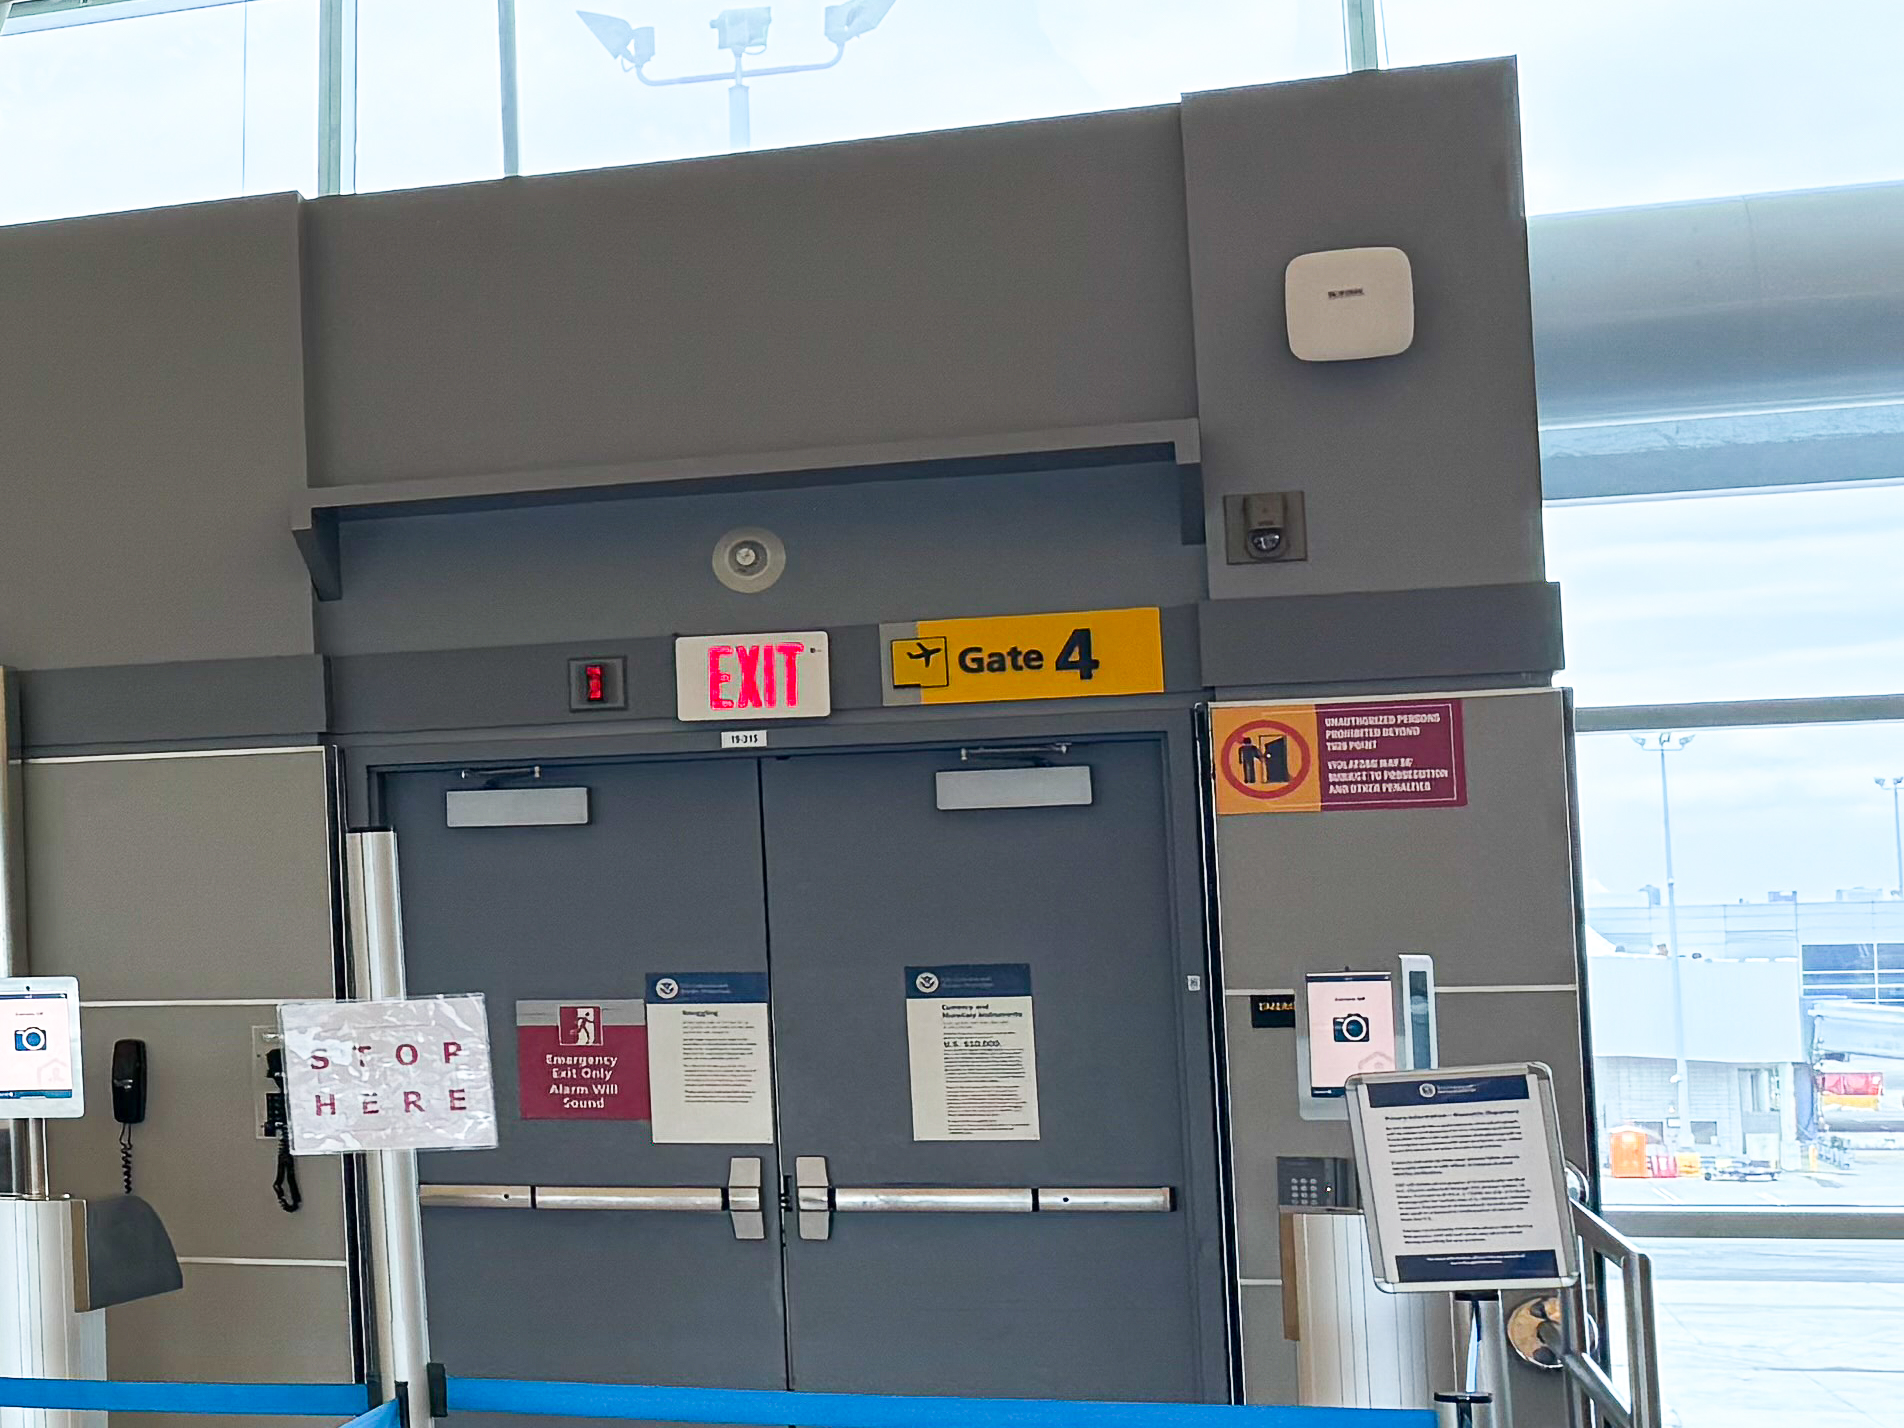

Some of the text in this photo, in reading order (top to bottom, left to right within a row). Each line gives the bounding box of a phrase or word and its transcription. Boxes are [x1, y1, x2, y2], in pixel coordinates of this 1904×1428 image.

[958, 628, 1100, 680] Gate 4
[708, 642, 804, 711] EXIT
[1325, 715, 1396, 727] UNAUTHORIZED
[1325, 726, 1420, 740] PROHIBITED BEYOND
[310, 1041, 463, 1070] STOP
[546, 1054, 618, 1068] Emergency
[552, 1067, 613, 1081] Exit Only
[549, 1084, 618, 1094] Alarm Will
[315, 1088, 467, 1117] HERE
[563, 1097, 604, 1109] Sound
